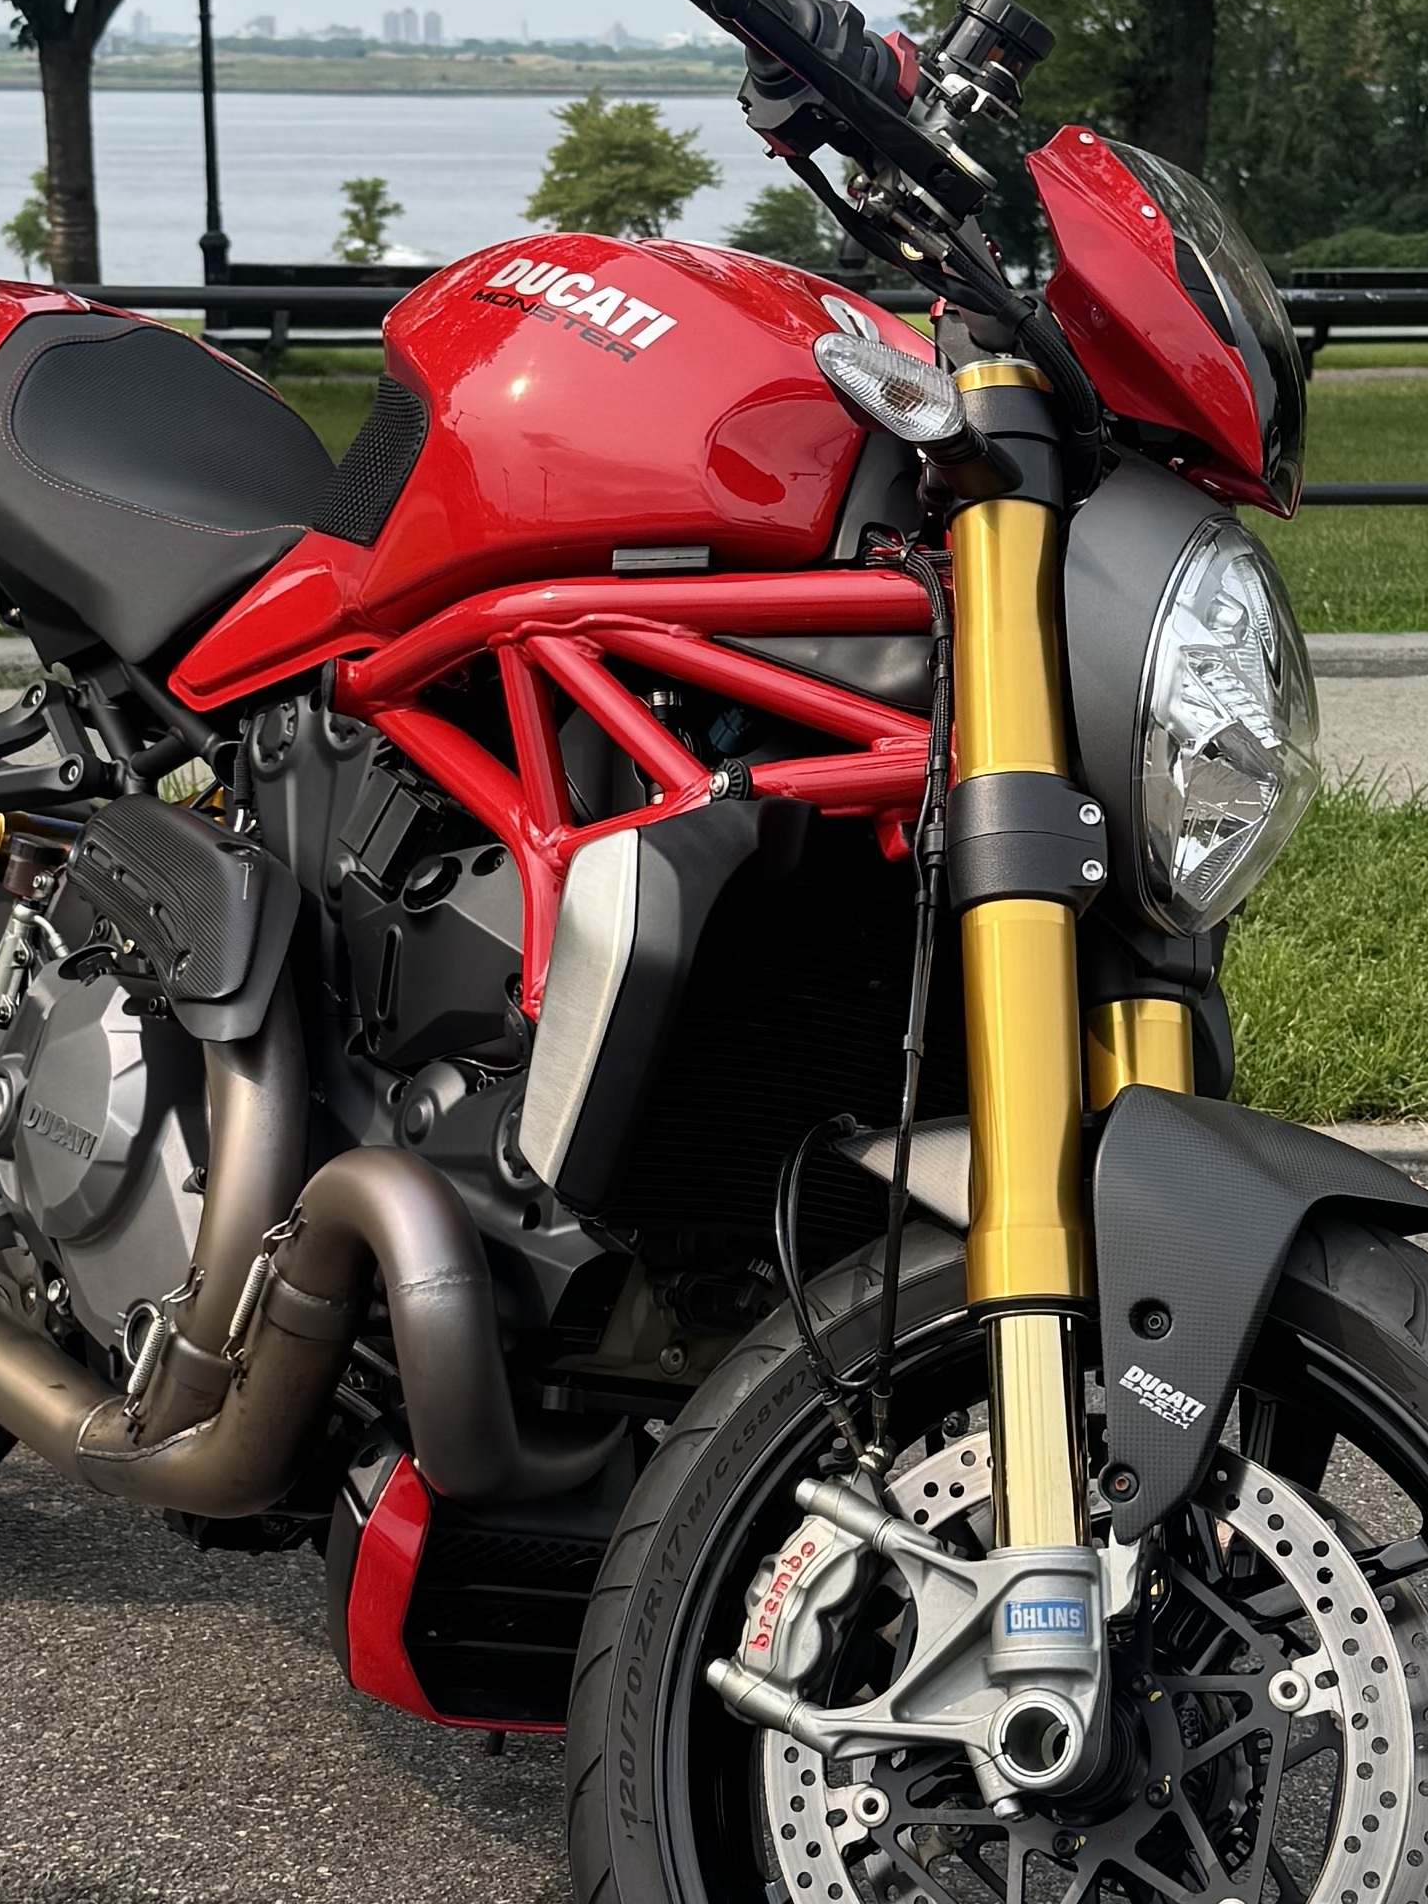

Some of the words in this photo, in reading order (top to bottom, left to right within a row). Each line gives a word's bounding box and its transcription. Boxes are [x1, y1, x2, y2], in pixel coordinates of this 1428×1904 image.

[470, 289, 637, 363] MONSTER
[485, 258, 678, 350] DUCATI
[22, 1100, 99, 1159] DUCATI
[1123, 1365, 1206, 1418] DUCATI
[749, 1541, 816, 1651] brembo
[1010, 1603, 1081, 1630] ÖHLINS
[619, 1666, 643, 1829] 120/70
